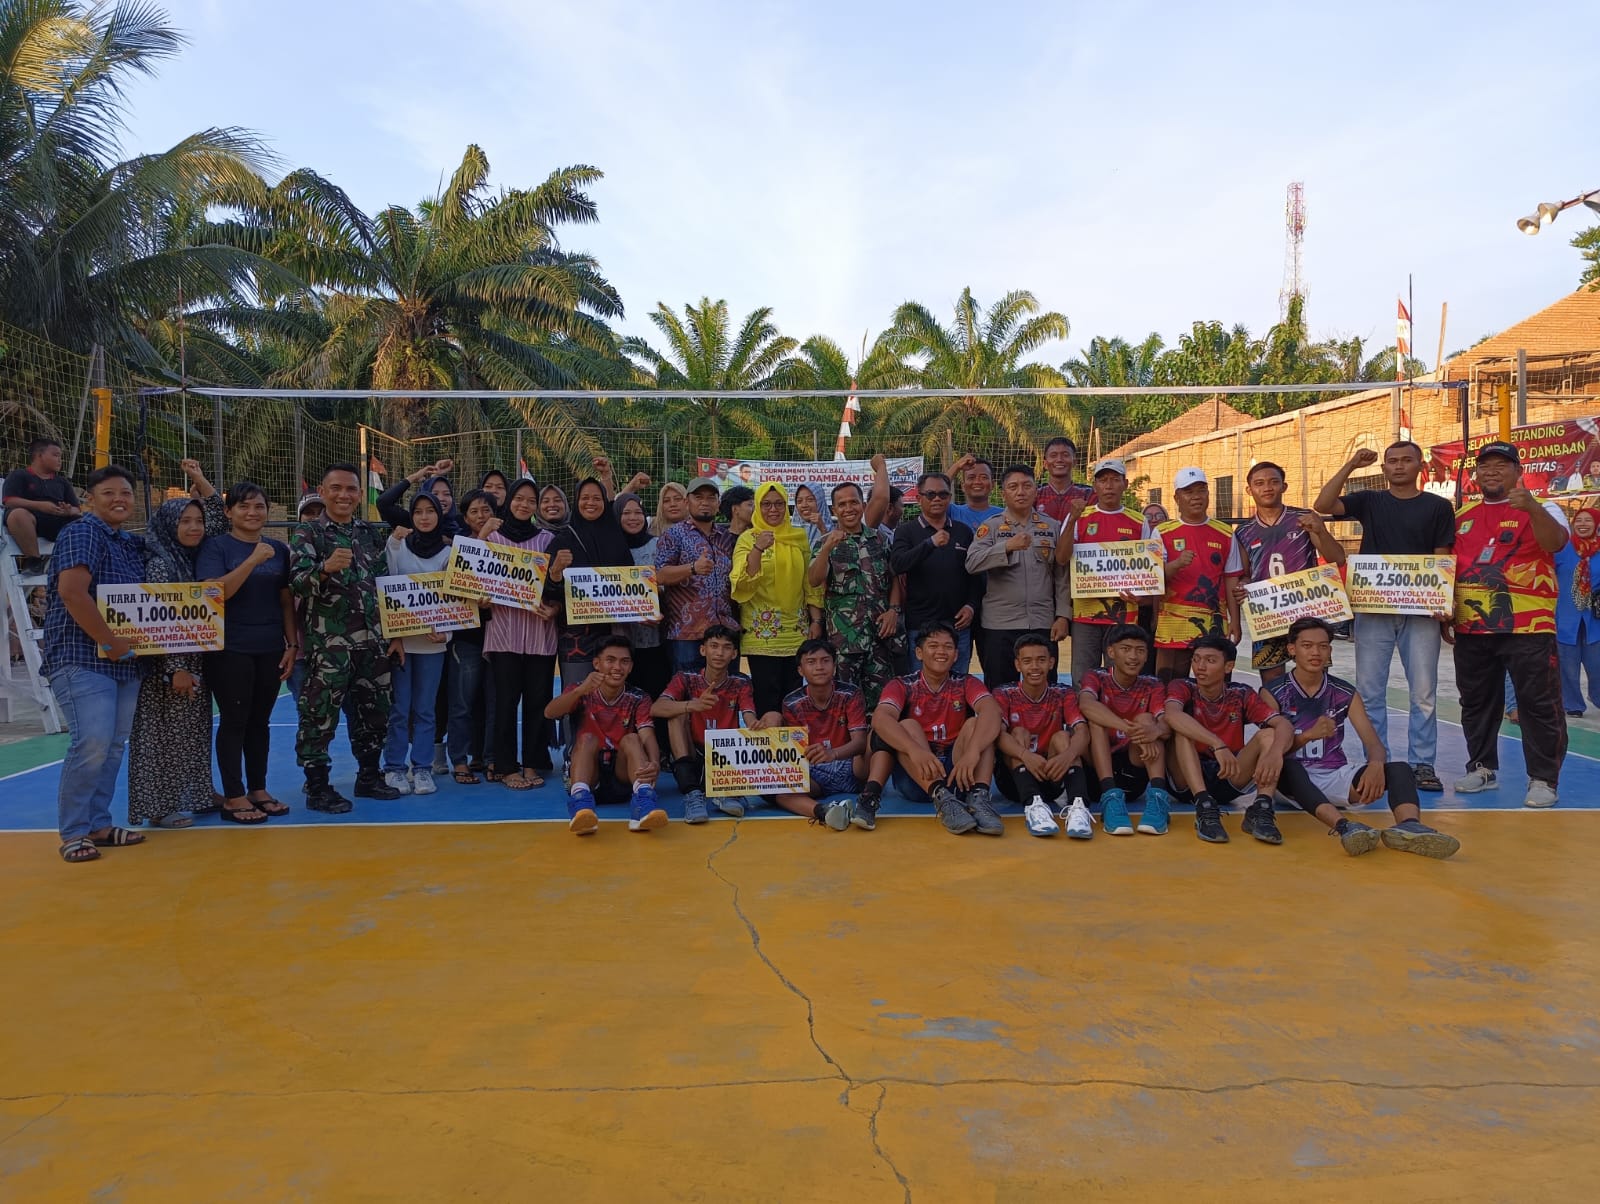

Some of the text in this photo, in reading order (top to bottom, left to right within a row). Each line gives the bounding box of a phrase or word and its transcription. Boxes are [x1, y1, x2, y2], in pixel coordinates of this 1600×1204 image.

[1468, 425, 1565, 450] SELAMA ERTANDING
[1529, 440, 1585, 458] DAMBAAN
[809, 474, 860, 482] DAMBAAN
[863, 474, 875, 482] CU
[458, 544, 515, 562] JUARA II PUTRI
[1076, 550, 1097, 560] JUARA
[1111, 548, 1134, 556] PUTRA
[455, 555, 473, 572] Rp.
[477, 560, 540, 585] 3.000.000,-
[1076, 557, 1158, 575] Rp. 5.000.000,-
[1269, 553, 1285, 578] 6
[1354, 562, 1378, 571] JUARA
[453, 572, 537, 593] TOURNAMENT VOLLY BALL
[570, 575, 592, 584] JUARA
[601, 574, 621, 582] PUTRI
[1271, 586, 1278, 594] II
[1281, 579, 1305, 591] PUTRA
[1353, 573, 1448, 590] Rp. 2.500.000,-
[384, 583, 407, 595] JUARA
[410, 582, 420, 590] III
[450, 579, 467, 587] LIGA
[468, 582, 483, 590] PRO
[484, 584, 521, 598] DAMBAAN
[522, 591, 536, 600] CUP
[571, 583, 653, 600] Rp. 5.000.000,-
[106, 592, 183, 606] JUARA IV PUTRI
[385, 596, 405, 611] Rp.
[1248, 584, 1339, 615] Rp. 7.500.000,-
[106, 605, 218, 626] Rp. 1.000.000,-
[387, 610, 432, 619] TOURNAMENT
[422, 614, 458, 623] DAMBAAN
[1253, 599, 1342, 623] TOURNAMENT VOLLY BALL
[1254, 622, 1273, 630] LIGA
[1273, 618, 1288, 627] PRO
[1329, 605, 1344, 613] CUP
[111, 626, 166, 636] OURNAMENT
[169, 625, 195, 633] VOLLY
[153, 633, 198, 642] DAMBAAN
[932, 724, 947, 740] 11
[712, 737, 770, 750] JUARA I PUTRA
[712, 748, 805, 768] Rp. 10.000.000,-
[712, 769, 761, 777] TOURNAMENT
[712, 778, 730, 786] LIGA
[749, 776, 787, 784] DAMBAAN
[789, 774, 803, 782] CUP
